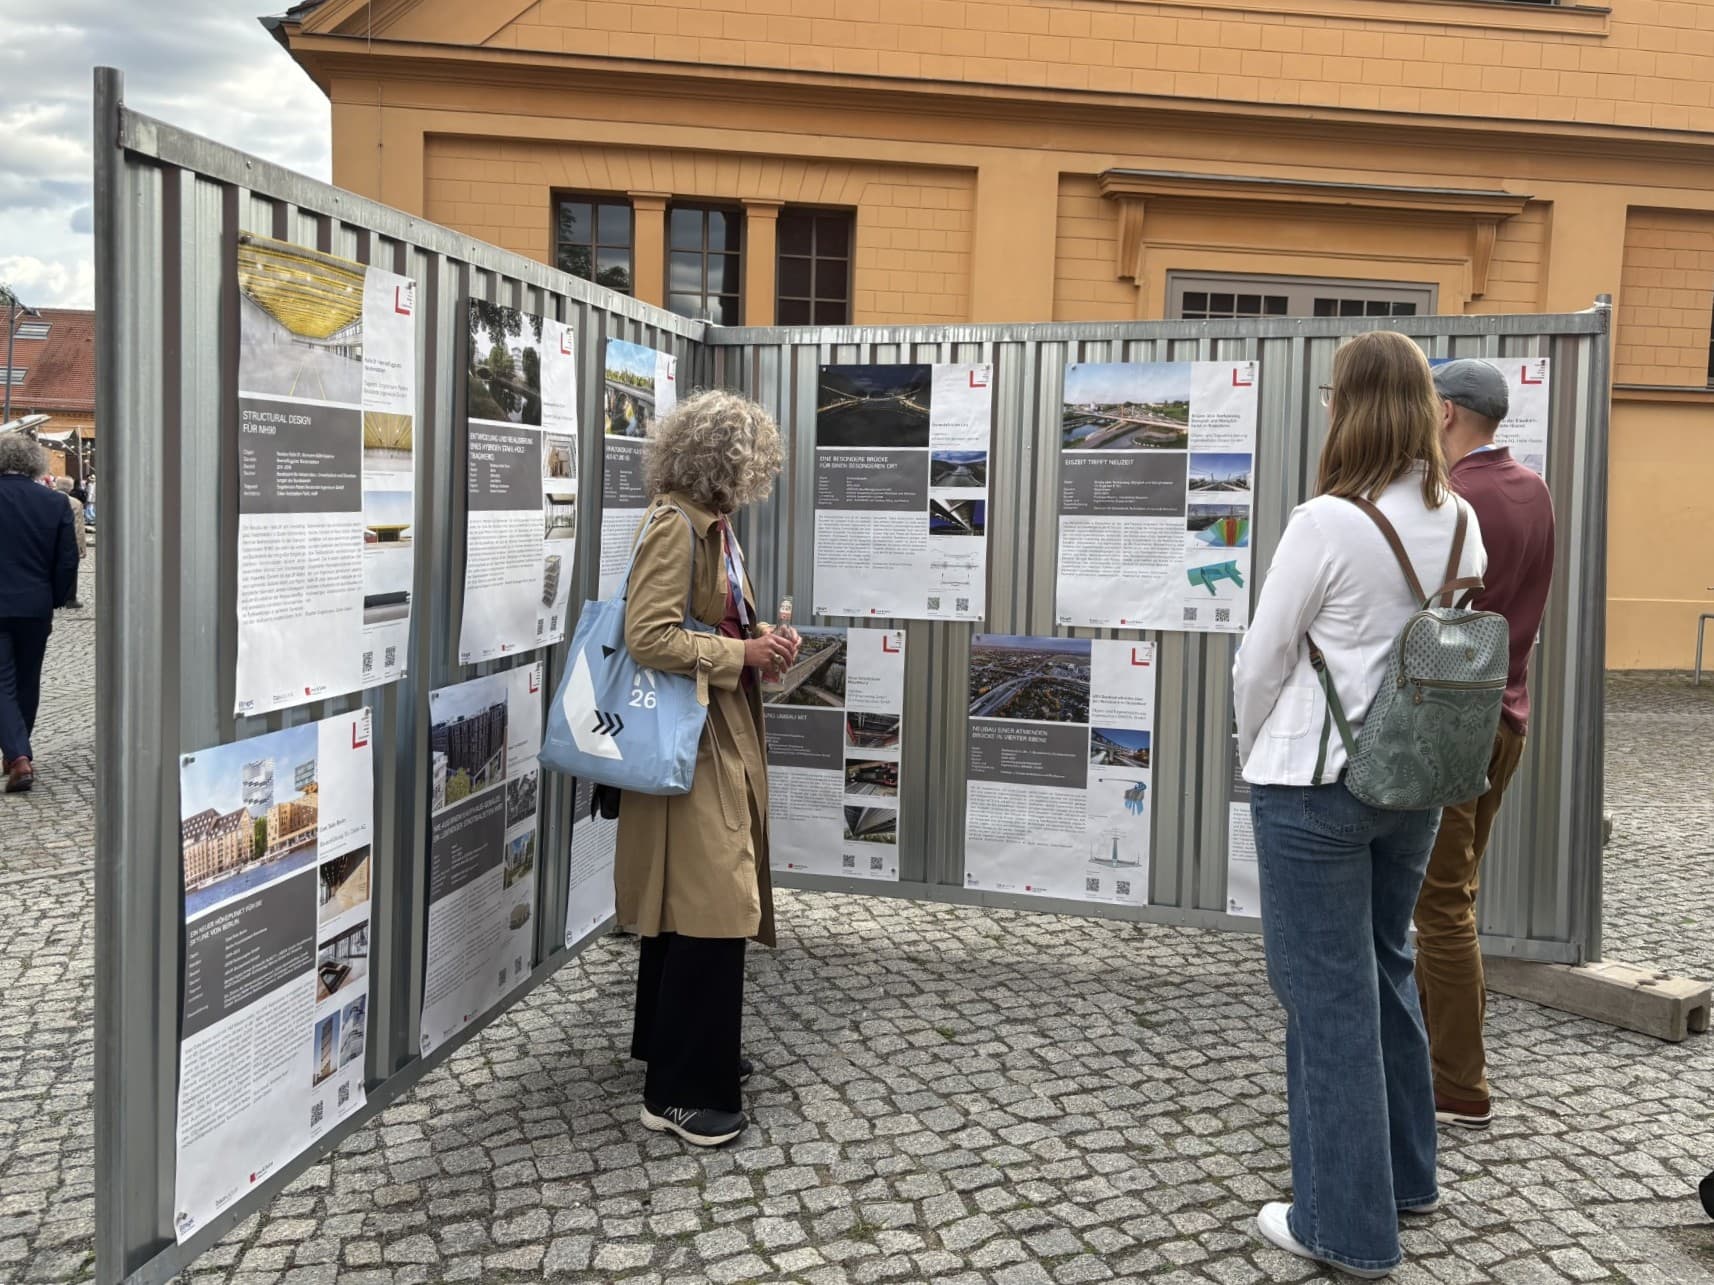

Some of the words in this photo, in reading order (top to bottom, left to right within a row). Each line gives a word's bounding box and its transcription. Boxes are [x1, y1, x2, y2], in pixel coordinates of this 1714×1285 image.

[242, 410, 288, 424] STRUCTURAL
[289, 414, 312, 425] DESIGN
[243, 422, 257, 433] FÜR
[866, 455, 889, 463] BRÜCKE
[628, 689, 657, 709] 26
